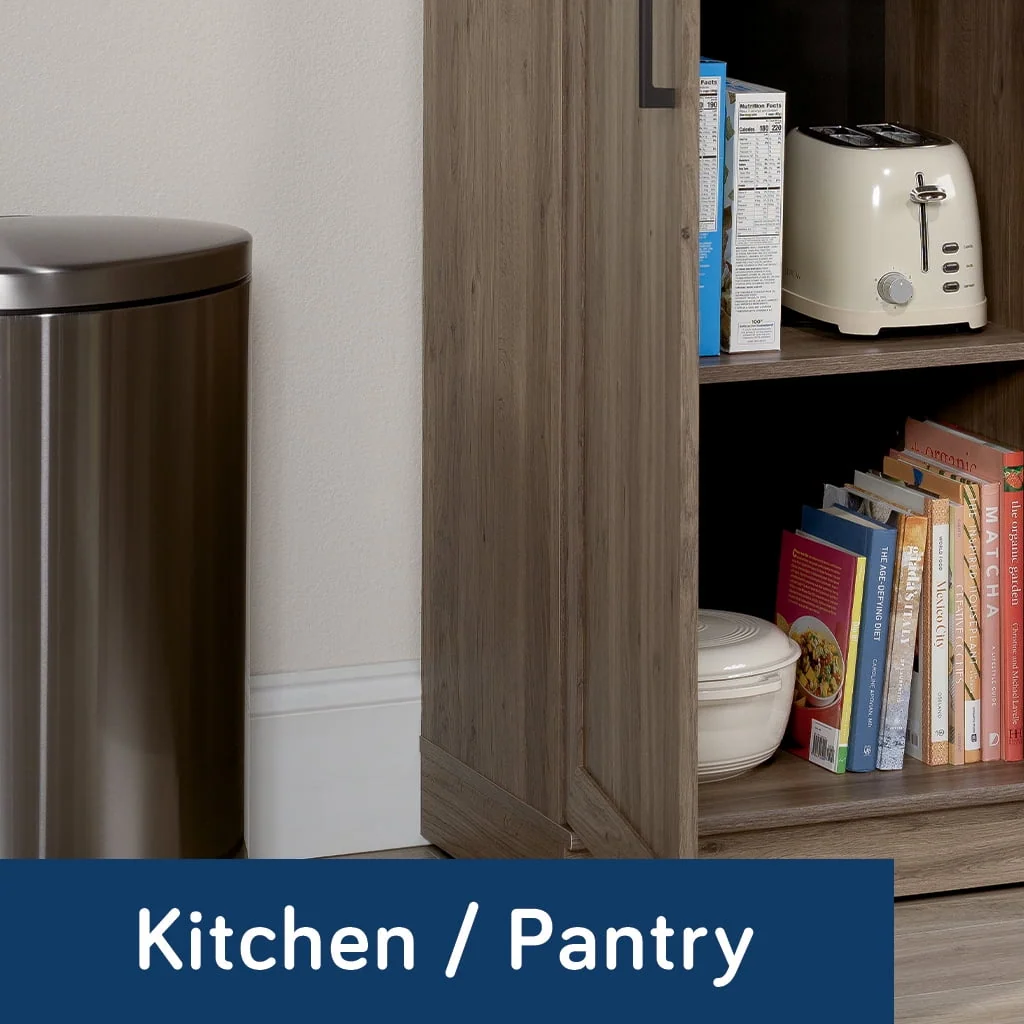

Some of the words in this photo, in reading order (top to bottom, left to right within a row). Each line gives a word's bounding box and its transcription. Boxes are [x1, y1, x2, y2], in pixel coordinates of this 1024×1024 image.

[1011, 500, 1021, 519] the
[880, 546, 889, 563] THE
[1008, 519, 1019, 564] organic
[985, 505, 1000, 618] MATCHA
[875, 564, 887, 621] AGE-DEFYING
[935, 580, 946, 623] Mexico
[1008, 566, 1021, 606] garden
[873, 622, 882, 642] DIET
[900, 603, 913, 645] ITALY
[933, 624, 946, 648] City
[1011, 622, 1020, 654] Christine
[869, 658, 878, 688] CAROLINE
[1011, 670, 1020, 699] Michael
[1011, 699, 1020, 726] Lavelle
